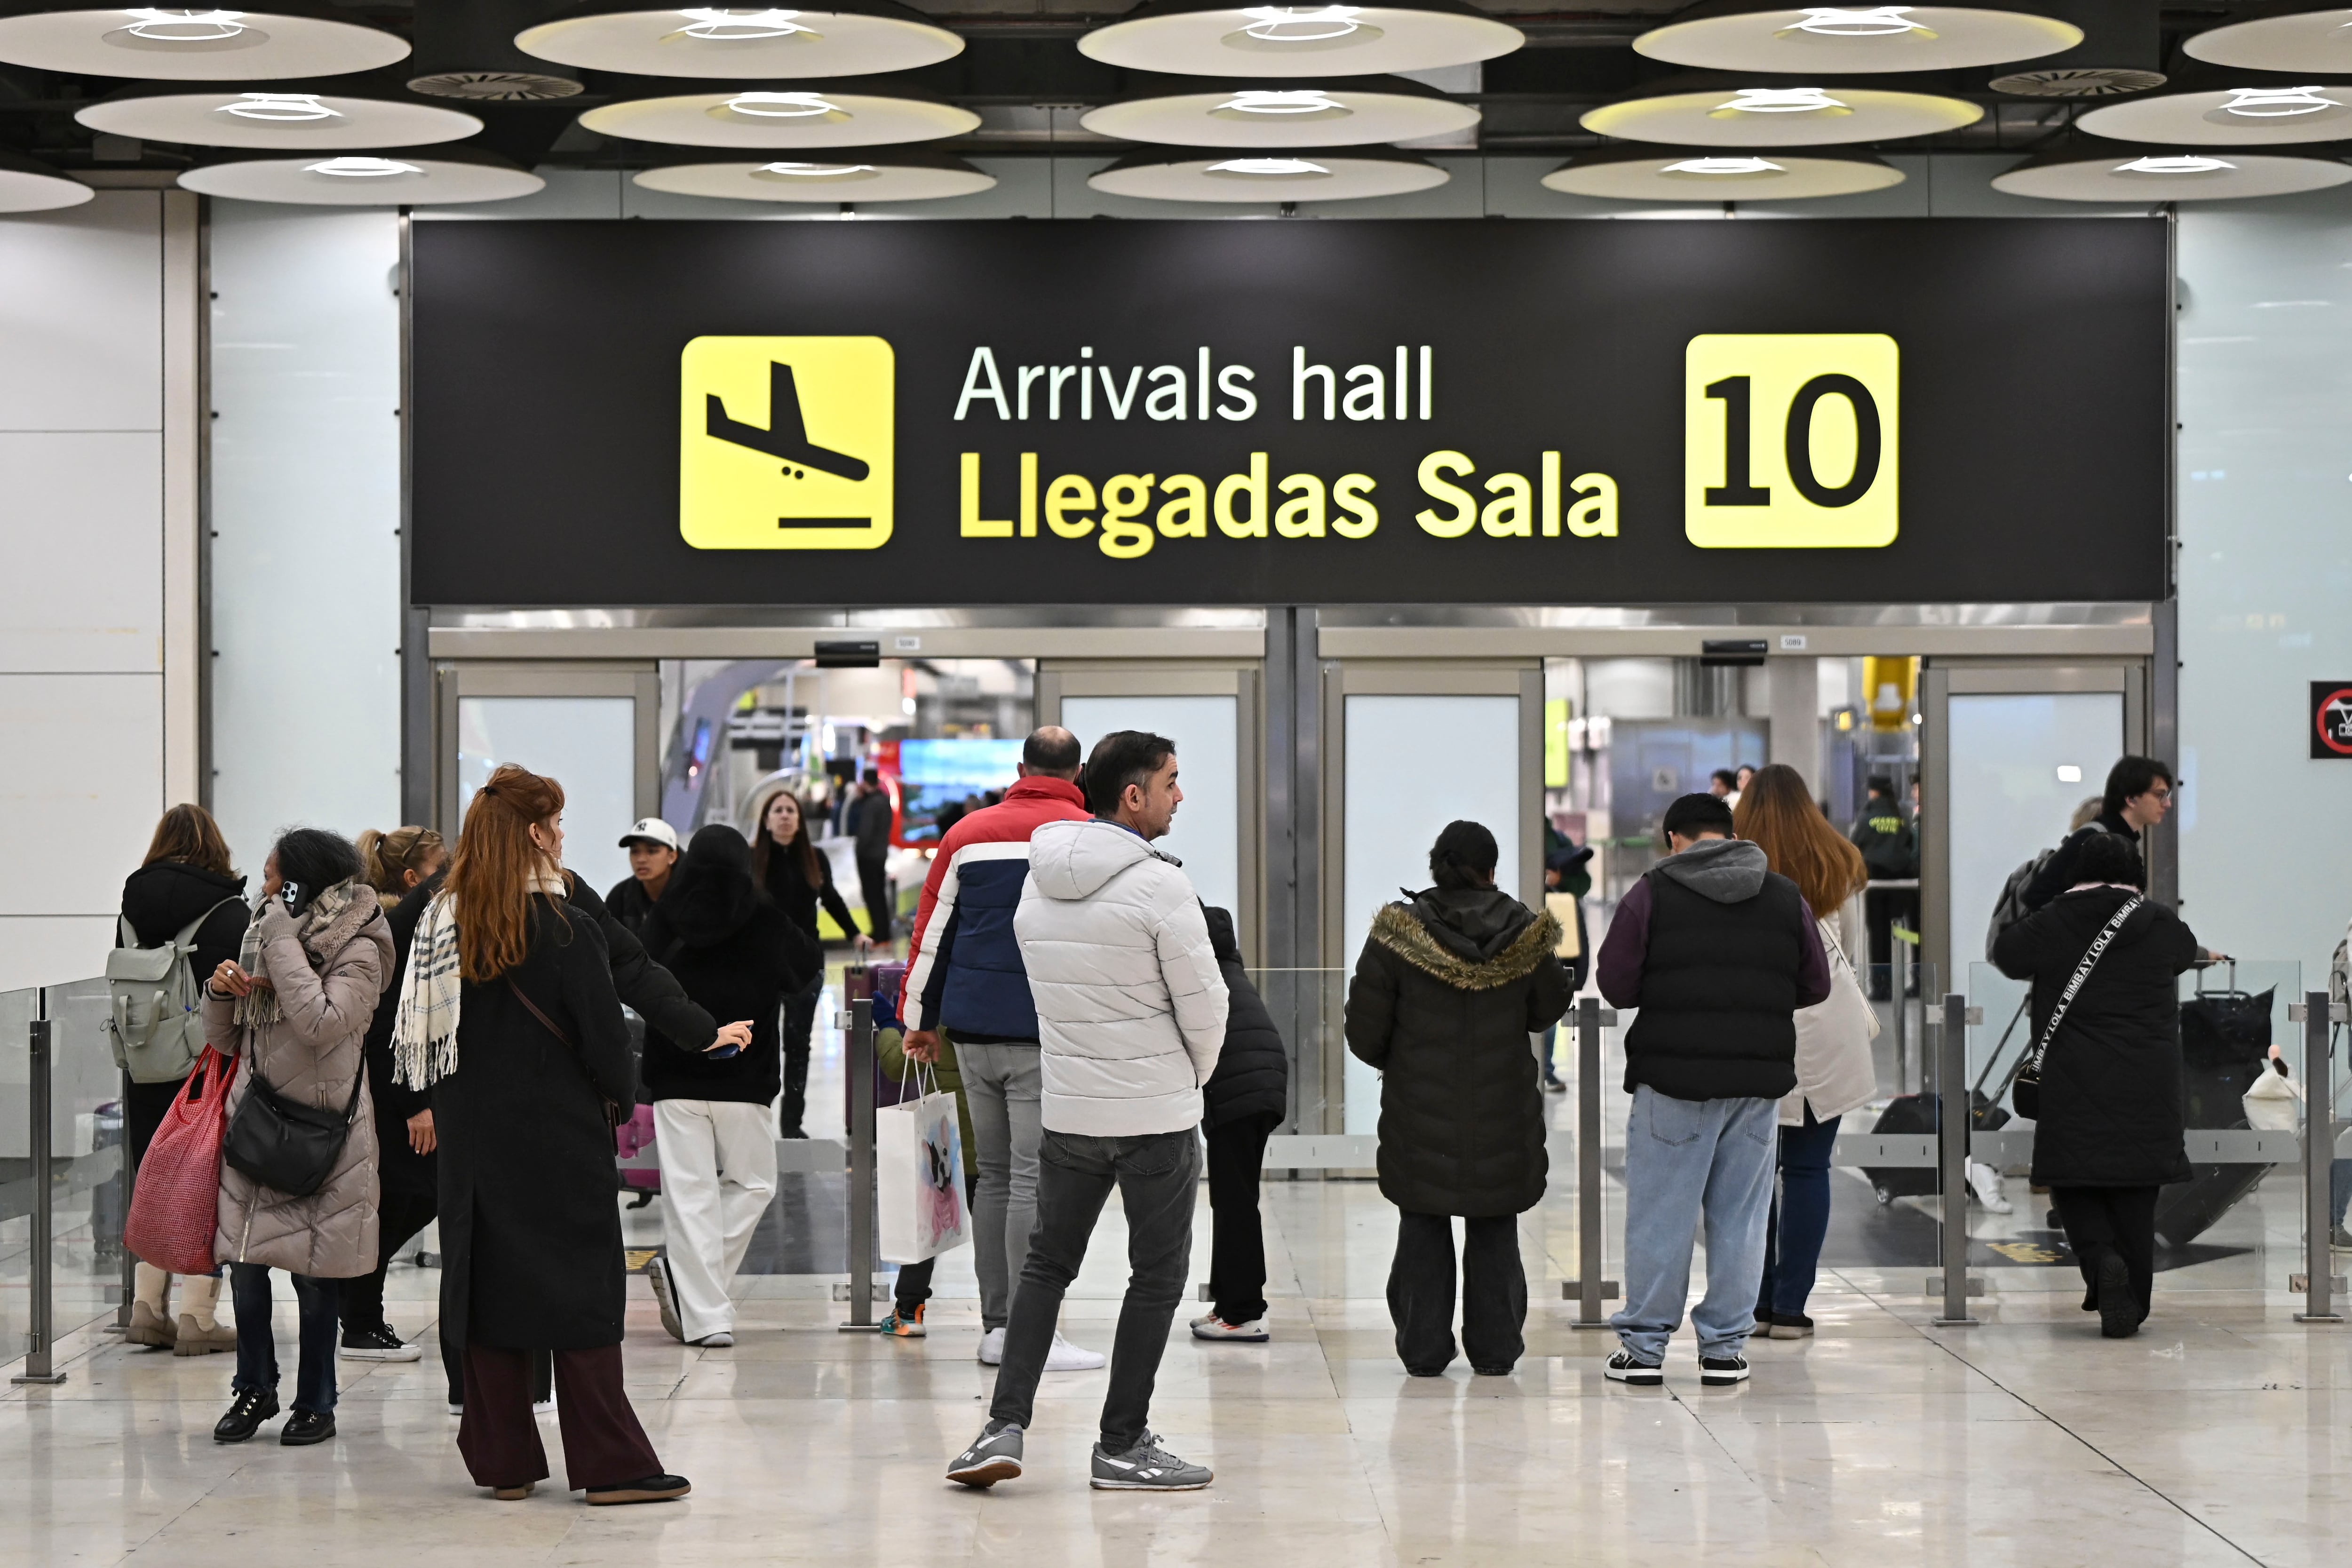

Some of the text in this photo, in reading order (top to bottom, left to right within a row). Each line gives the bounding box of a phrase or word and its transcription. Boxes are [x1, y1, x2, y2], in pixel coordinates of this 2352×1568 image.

[954, 346, 1432, 422] Arrivals hall
[1705, 374, 1882, 508] 10
[960, 450, 1619, 558] Llegadas Sala
[2048, 1004, 2066, 1033] LOLA
[2088, 929, 2114, 958] LOLA
